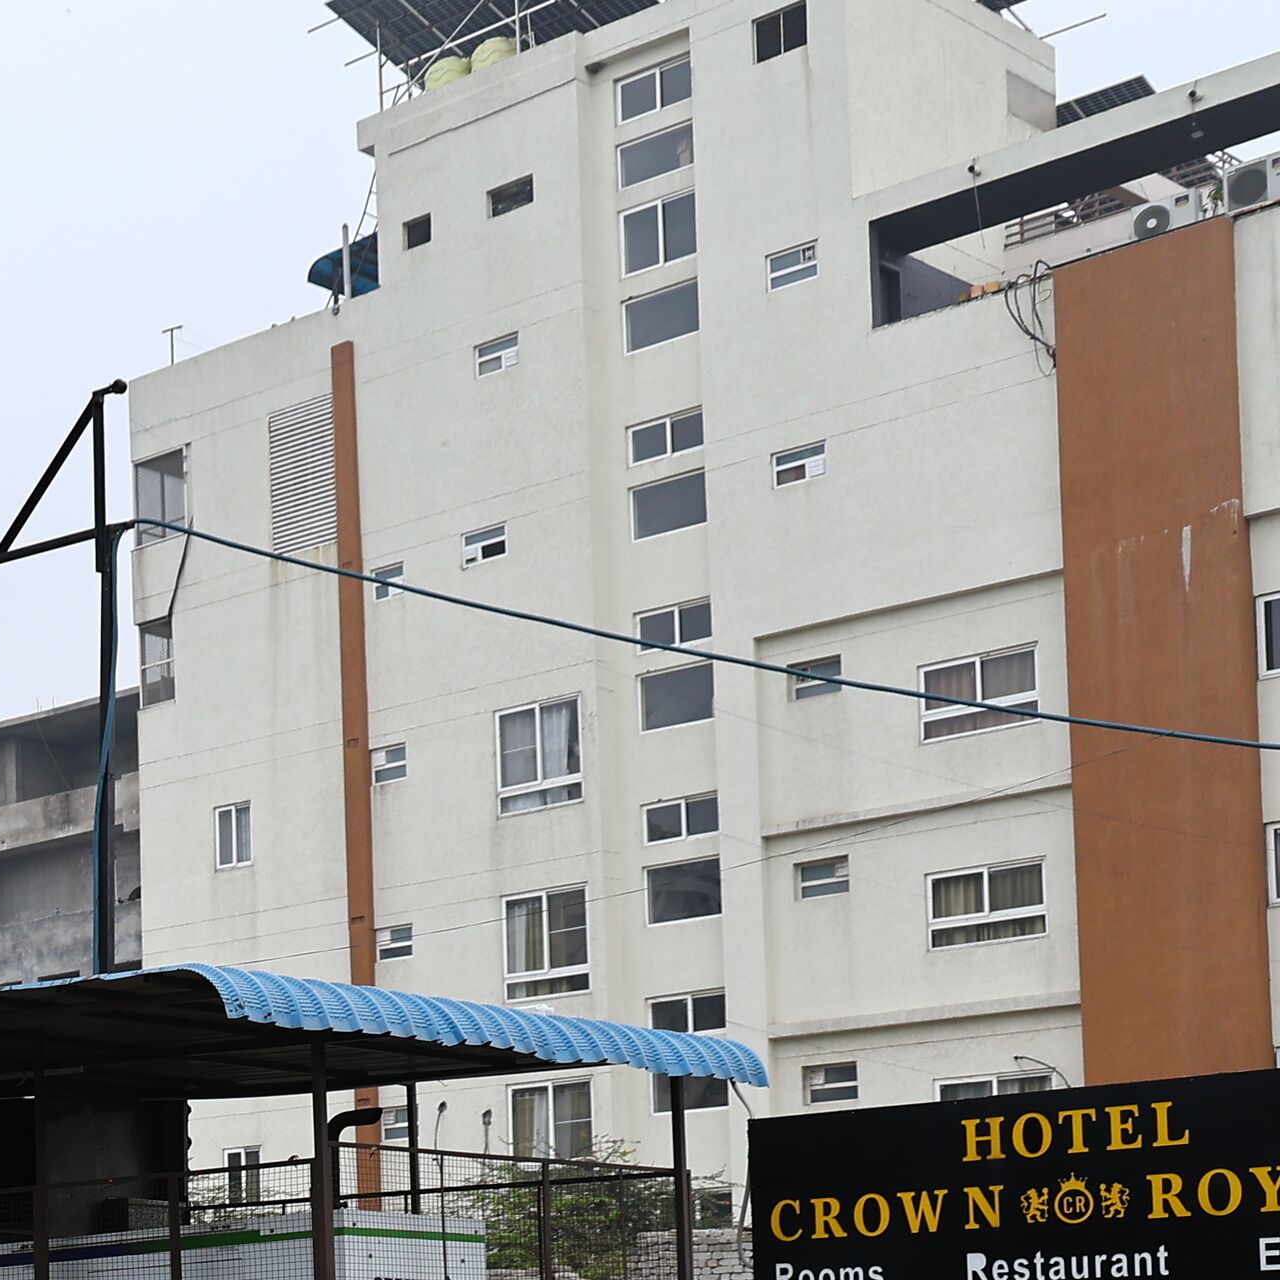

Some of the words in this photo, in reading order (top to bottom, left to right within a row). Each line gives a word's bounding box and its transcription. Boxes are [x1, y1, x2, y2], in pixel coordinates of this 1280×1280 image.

[961, 1101, 1190, 1162] HOTEL
[770, 1184, 1004, 1242] CROWN
[1063, 1196, 1087, 1214] CR
